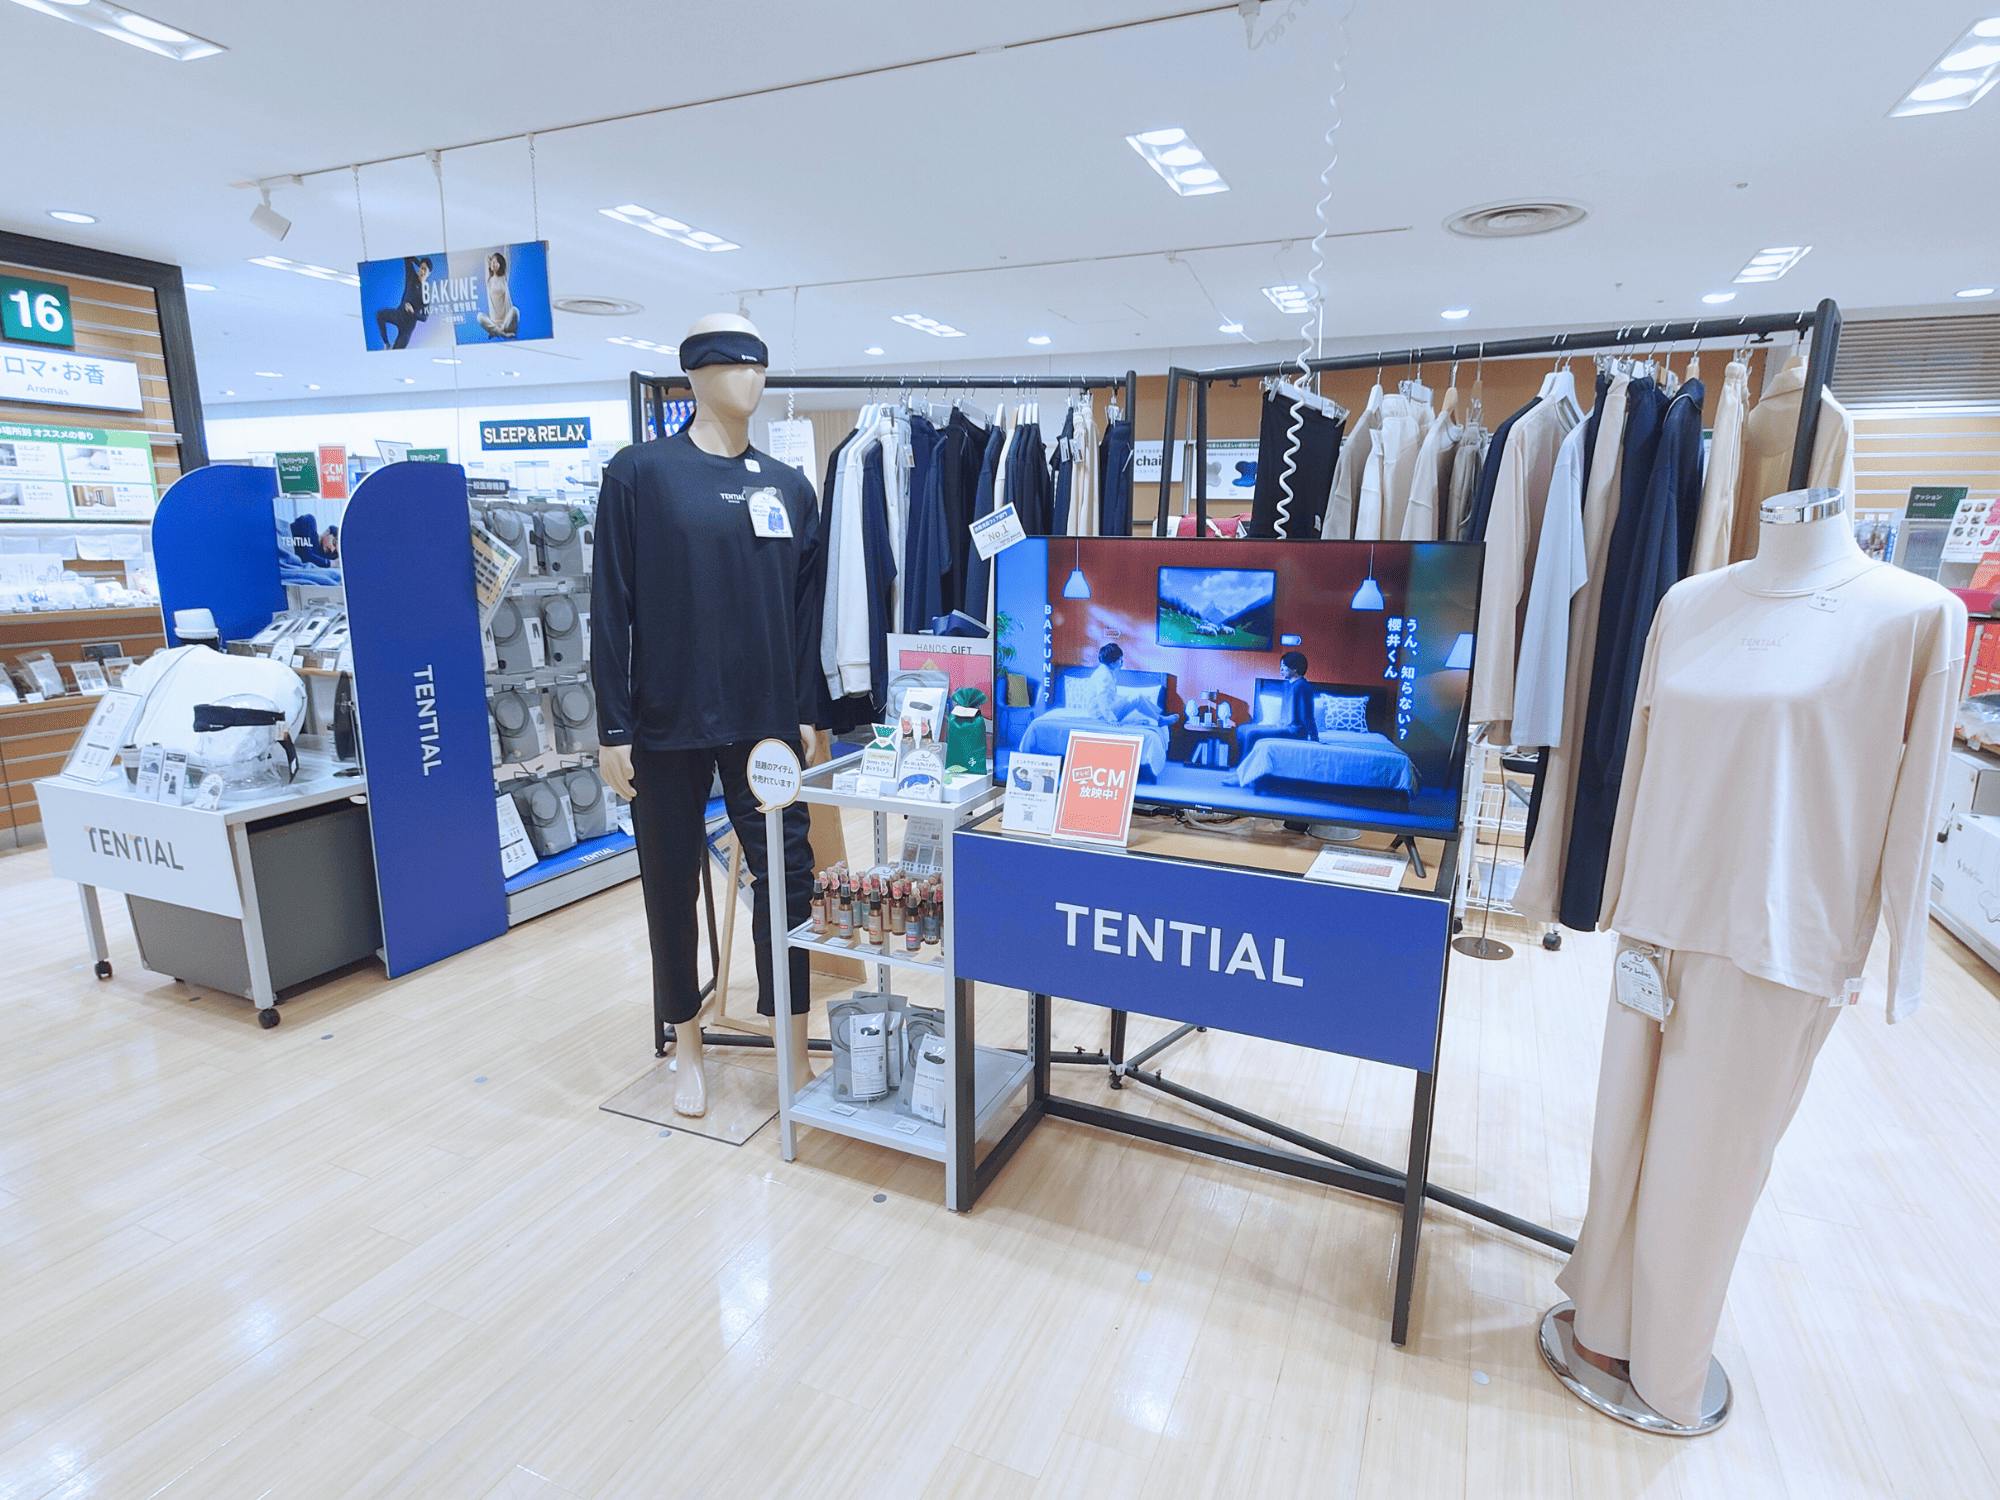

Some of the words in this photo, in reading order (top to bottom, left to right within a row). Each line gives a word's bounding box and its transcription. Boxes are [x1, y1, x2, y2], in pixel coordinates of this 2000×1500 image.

[422, 277, 478, 304] BAKUNE
[9, 290, 64, 332] 16
[3, 355, 105, 385] ロマ・お香
[27, 384, 69, 396] Aromas
[0, 426, 32, 437] 場所別
[483, 424, 586, 443] SLEEP&RELAX
[282, 537, 314, 548] TENTIAL
[917, 643, 947, 653] HANDS
[951, 645, 973, 655] GIFT
[1384, 617, 1403, 679] 櫻井くん
[413, 664, 442, 776] TENTIAL
[1092, 767, 1126, 789] CM
[1079, 786, 1119, 800] 放映中!
[84, 825, 184, 870] TENTIAL
[578, 847, 616, 863] TENTIAL
[1055, 901, 1304, 987] TENTIAL
